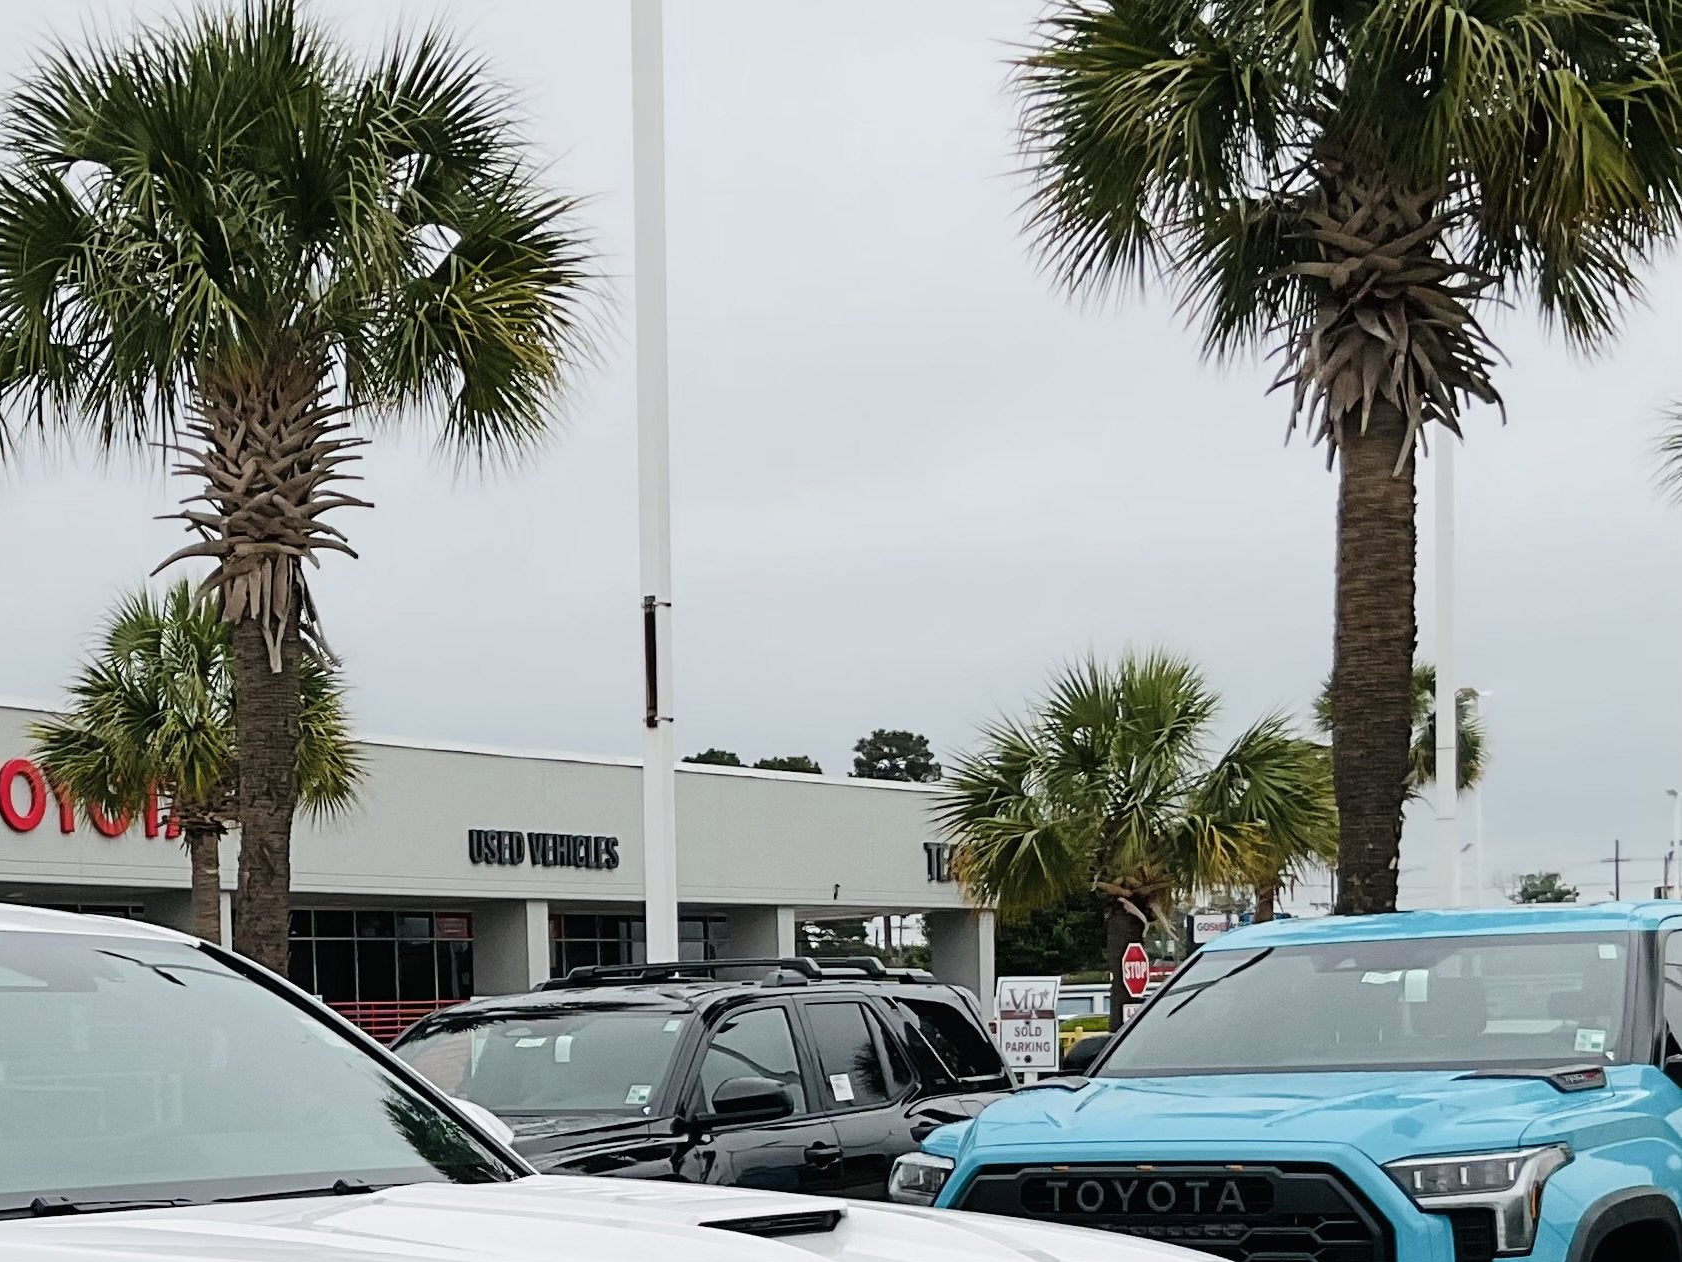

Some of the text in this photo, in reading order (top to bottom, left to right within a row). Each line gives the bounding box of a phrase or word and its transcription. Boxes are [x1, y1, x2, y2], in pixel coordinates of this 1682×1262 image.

[468, 828, 620, 870] USED VEHICLES
[1124, 960, 1147, 980] STOP
[1014, 1026, 1042, 1038] SOLD
[1005, 1041, 1051, 1053] PARKING
[1045, 1179, 1247, 1214] TOYOTA
